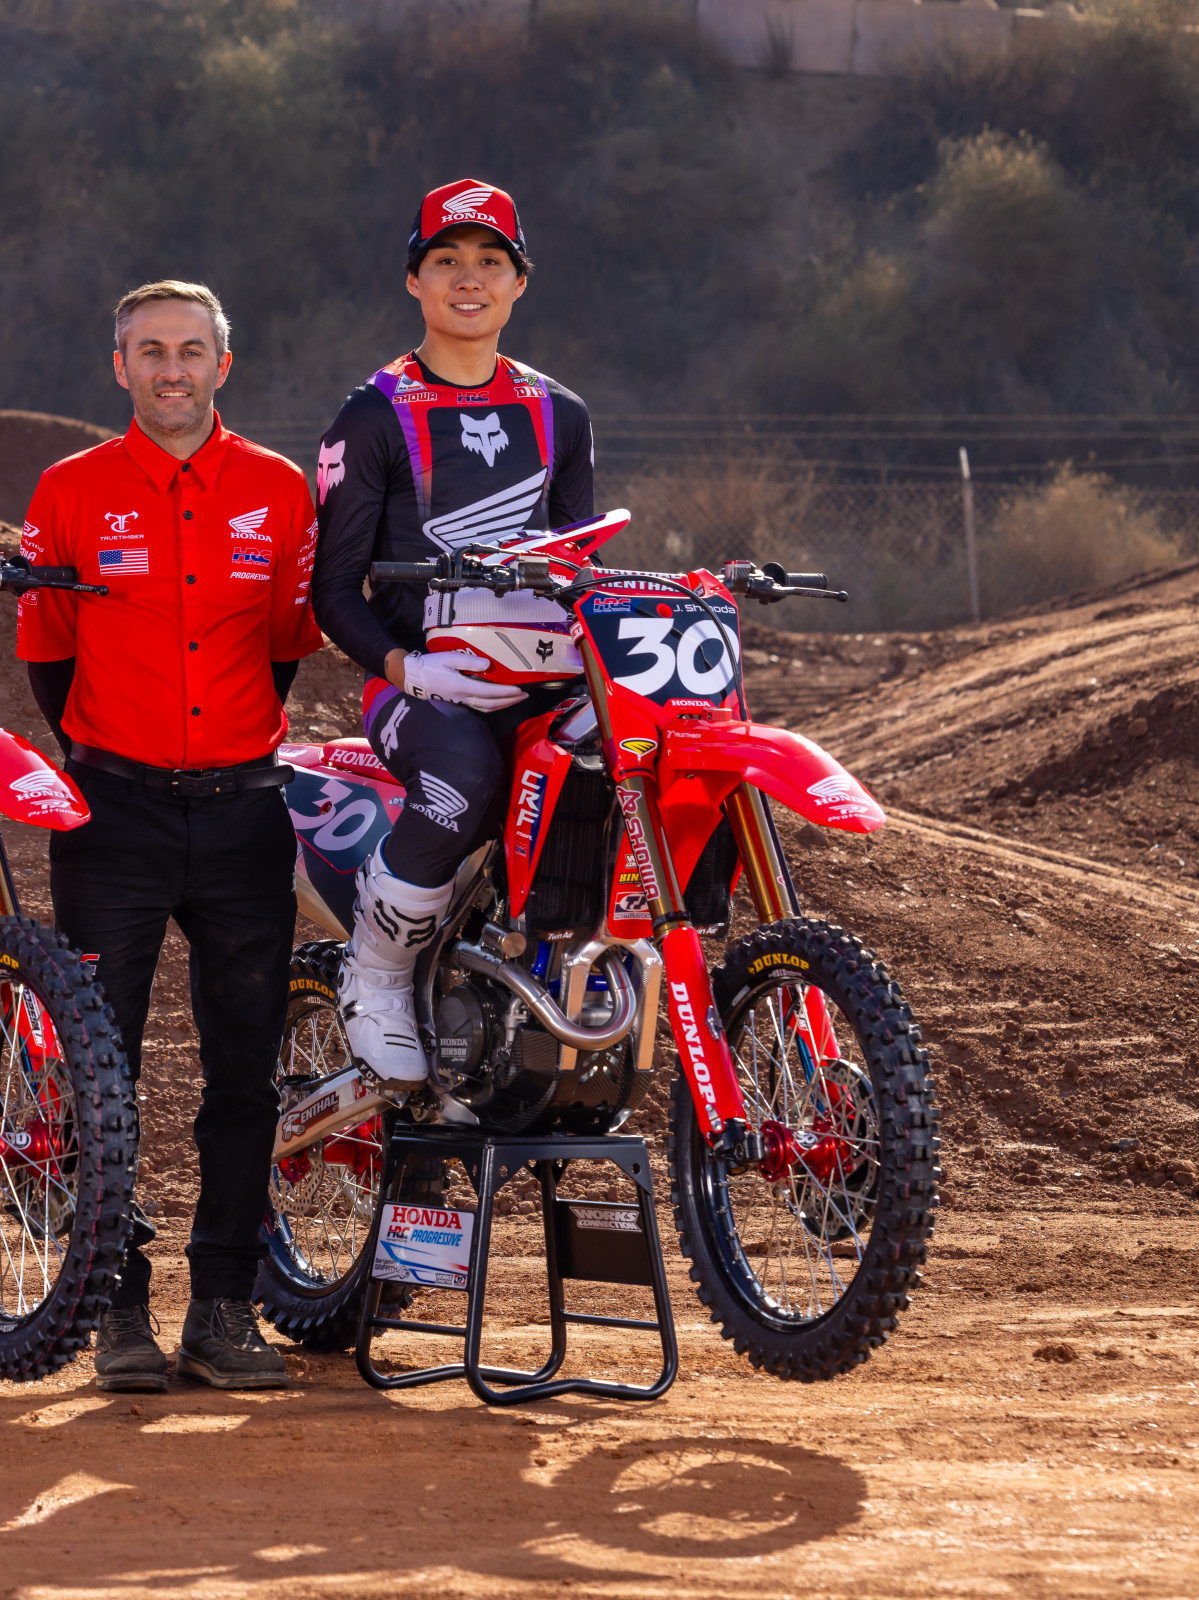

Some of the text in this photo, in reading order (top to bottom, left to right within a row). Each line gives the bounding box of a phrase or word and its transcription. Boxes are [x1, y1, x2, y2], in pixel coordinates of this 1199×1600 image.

[441, 212, 498, 224] HONDA
[392, 392, 438, 404] SHOWA
[457, 391, 489, 402] HRC
[230, 532, 273, 543] HONDA
[232, 546, 273, 563] HRC
[230, 571, 271, 581] PROGRESSIVE
[593, 598, 631, 609] HRC
[673, 605, 684, 613] J.
[613, 618, 740, 696] 30
[16, 790, 79, 803] HONDA
[516, 769, 543, 827] CRF
[409, 803, 460, 832] HONDA
[624, 816, 660, 901] SHOWA
[753, 953, 810, 972] DUNLOP
[289, 978, 336, 999] DUNLOP
[440, 1038, 468, 1046] HONDA
[670, 982, 716, 1104] DUNLOP
[392, 1206, 462, 1229] HONDA
[573, 1208, 636, 1222] WORKS
[578, 1220, 638, 1230] CONNECTION
[387, 1225, 463, 1247] HRC PROGRESSIVE
